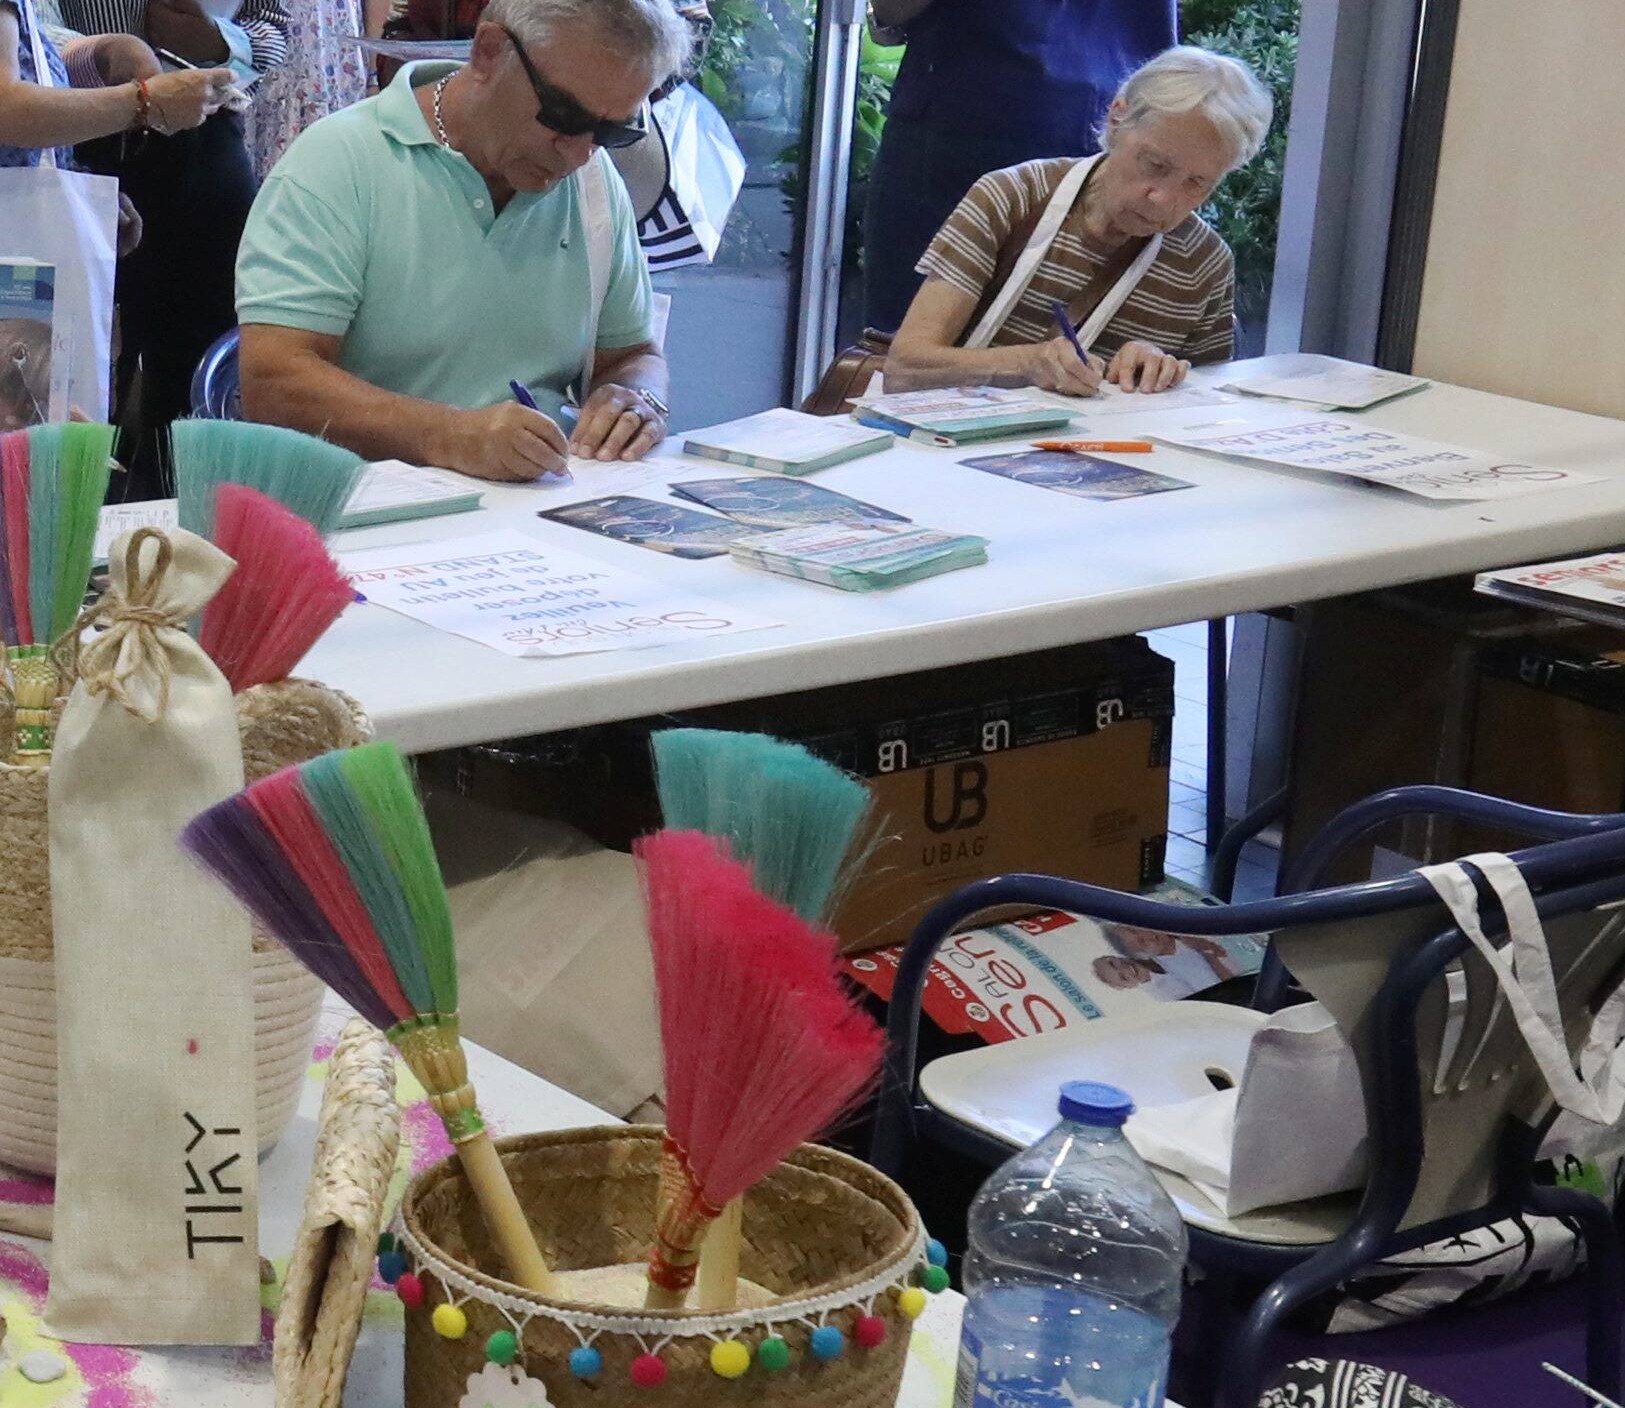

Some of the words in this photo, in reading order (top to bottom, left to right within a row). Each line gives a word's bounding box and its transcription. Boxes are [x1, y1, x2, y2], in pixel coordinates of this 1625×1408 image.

[436, 550, 545, 573] STAND
[398, 579, 521, 607] bulletin
[400, 577, 447, 592] AU
[524, 571, 609, 596] votre
[472, 587, 600, 613] déposer
[500, 599, 636, 623] Veuillez
[923, 759, 989, 834] UB
[921, 836, 986, 867] UBAG
[183, 1111, 244, 1260] TIKY
